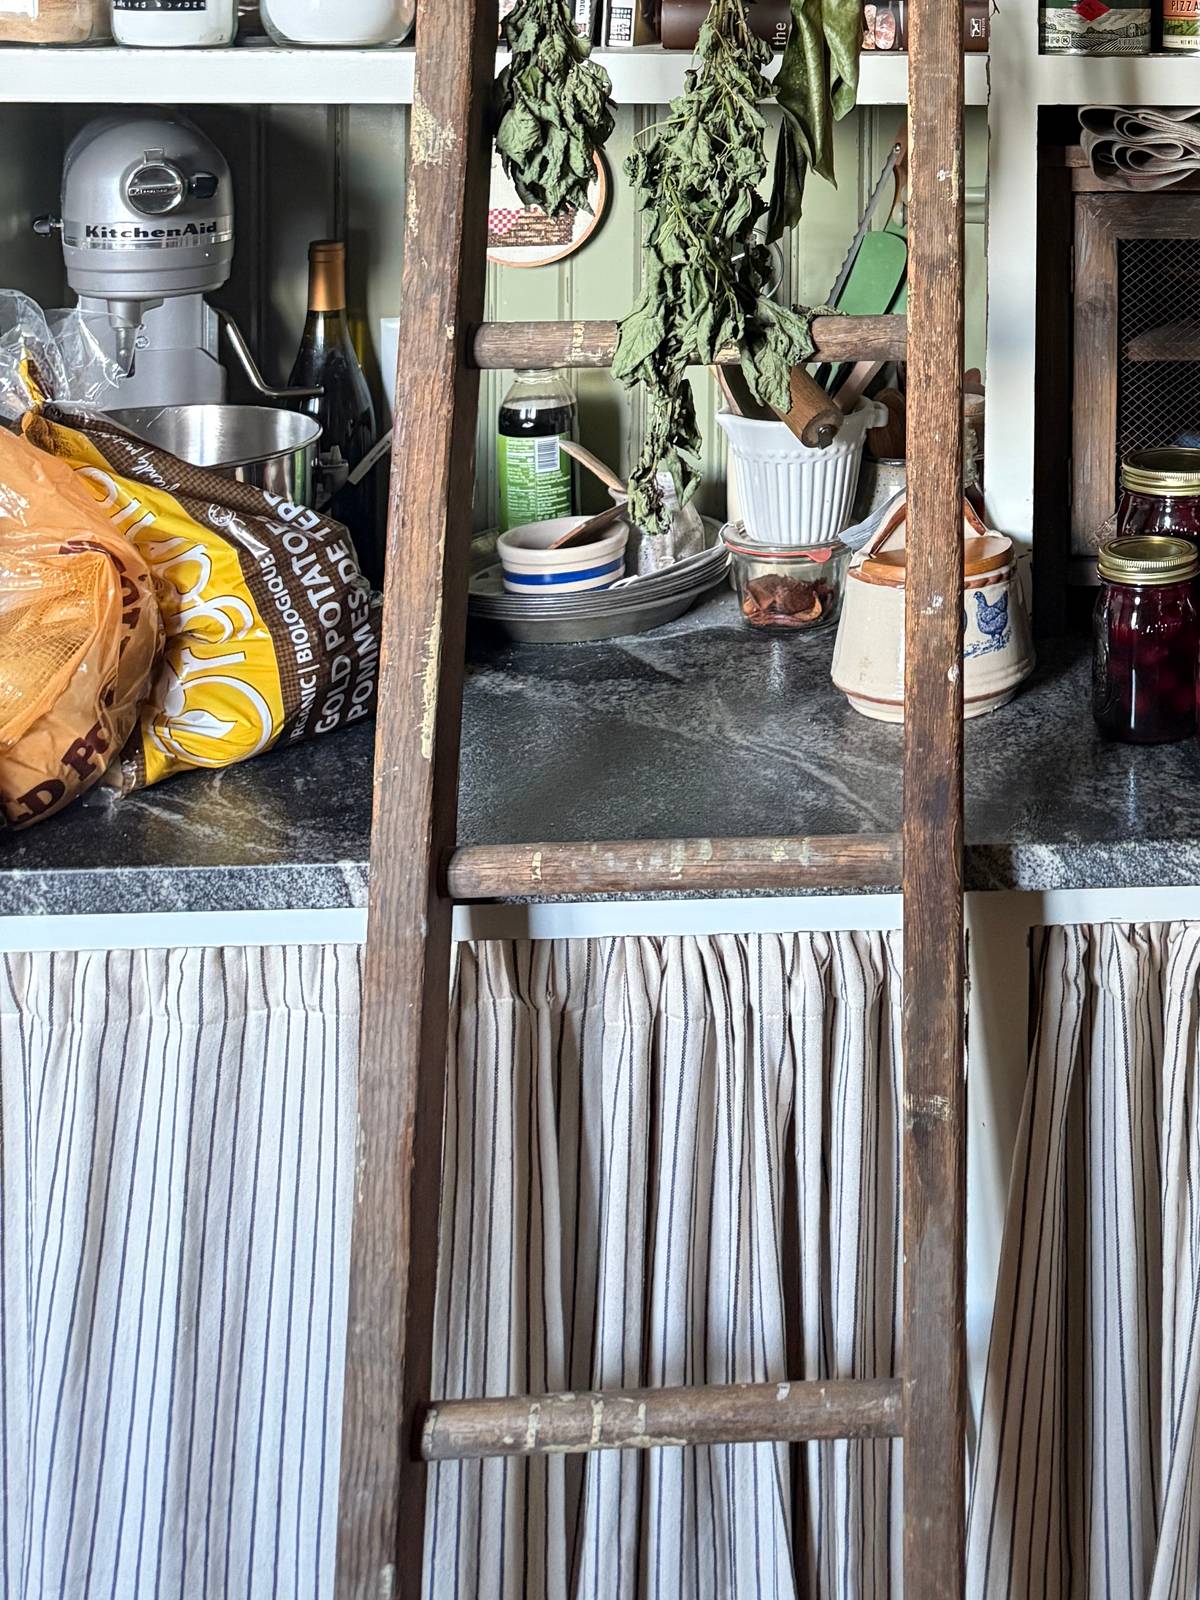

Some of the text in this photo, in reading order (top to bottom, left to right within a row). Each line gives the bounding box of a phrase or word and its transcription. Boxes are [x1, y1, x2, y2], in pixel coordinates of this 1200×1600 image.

[773, 22, 787, 46] the
[1171, 0, 1199, 11] PIZZA
[85, 221, 217, 238] KitchenAid
[78, 466, 274, 768] Organic
[259, 552, 313, 664] BIOLOGIQUE
[328, 539, 378, 722] POMMES DE
[315, 655, 352, 734] GOLD
